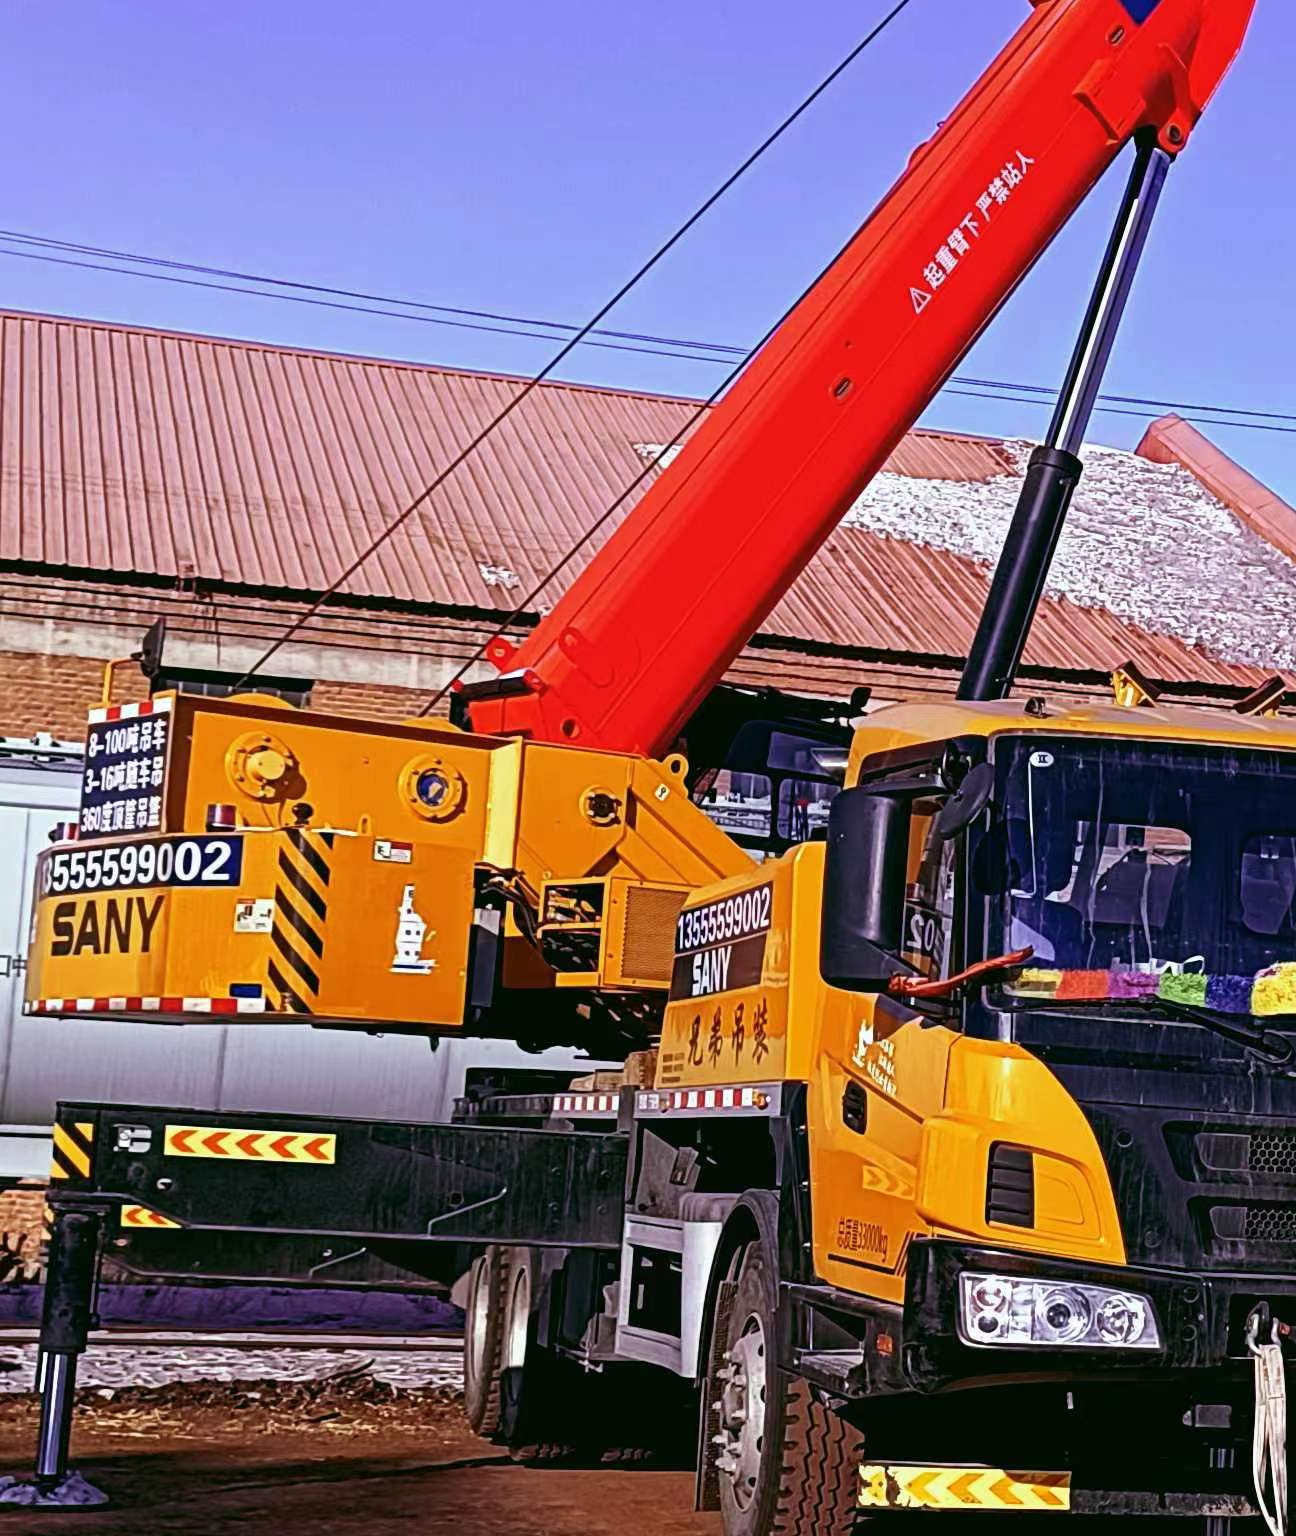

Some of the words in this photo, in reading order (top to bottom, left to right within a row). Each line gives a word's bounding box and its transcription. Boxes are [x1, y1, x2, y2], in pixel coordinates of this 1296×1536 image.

[923, 212, 980, 290] 起重臂下
[975, 150, 1035, 222] 严禁站人
[88, 718, 167, 758] 8-100吨吊车
[51, 895, 165, 956] SANY
[677, 887, 771, 950] 13555599002
[692, 945, 732, 996] SANY
[688, 997, 769, 1069] 兄弟吊装
